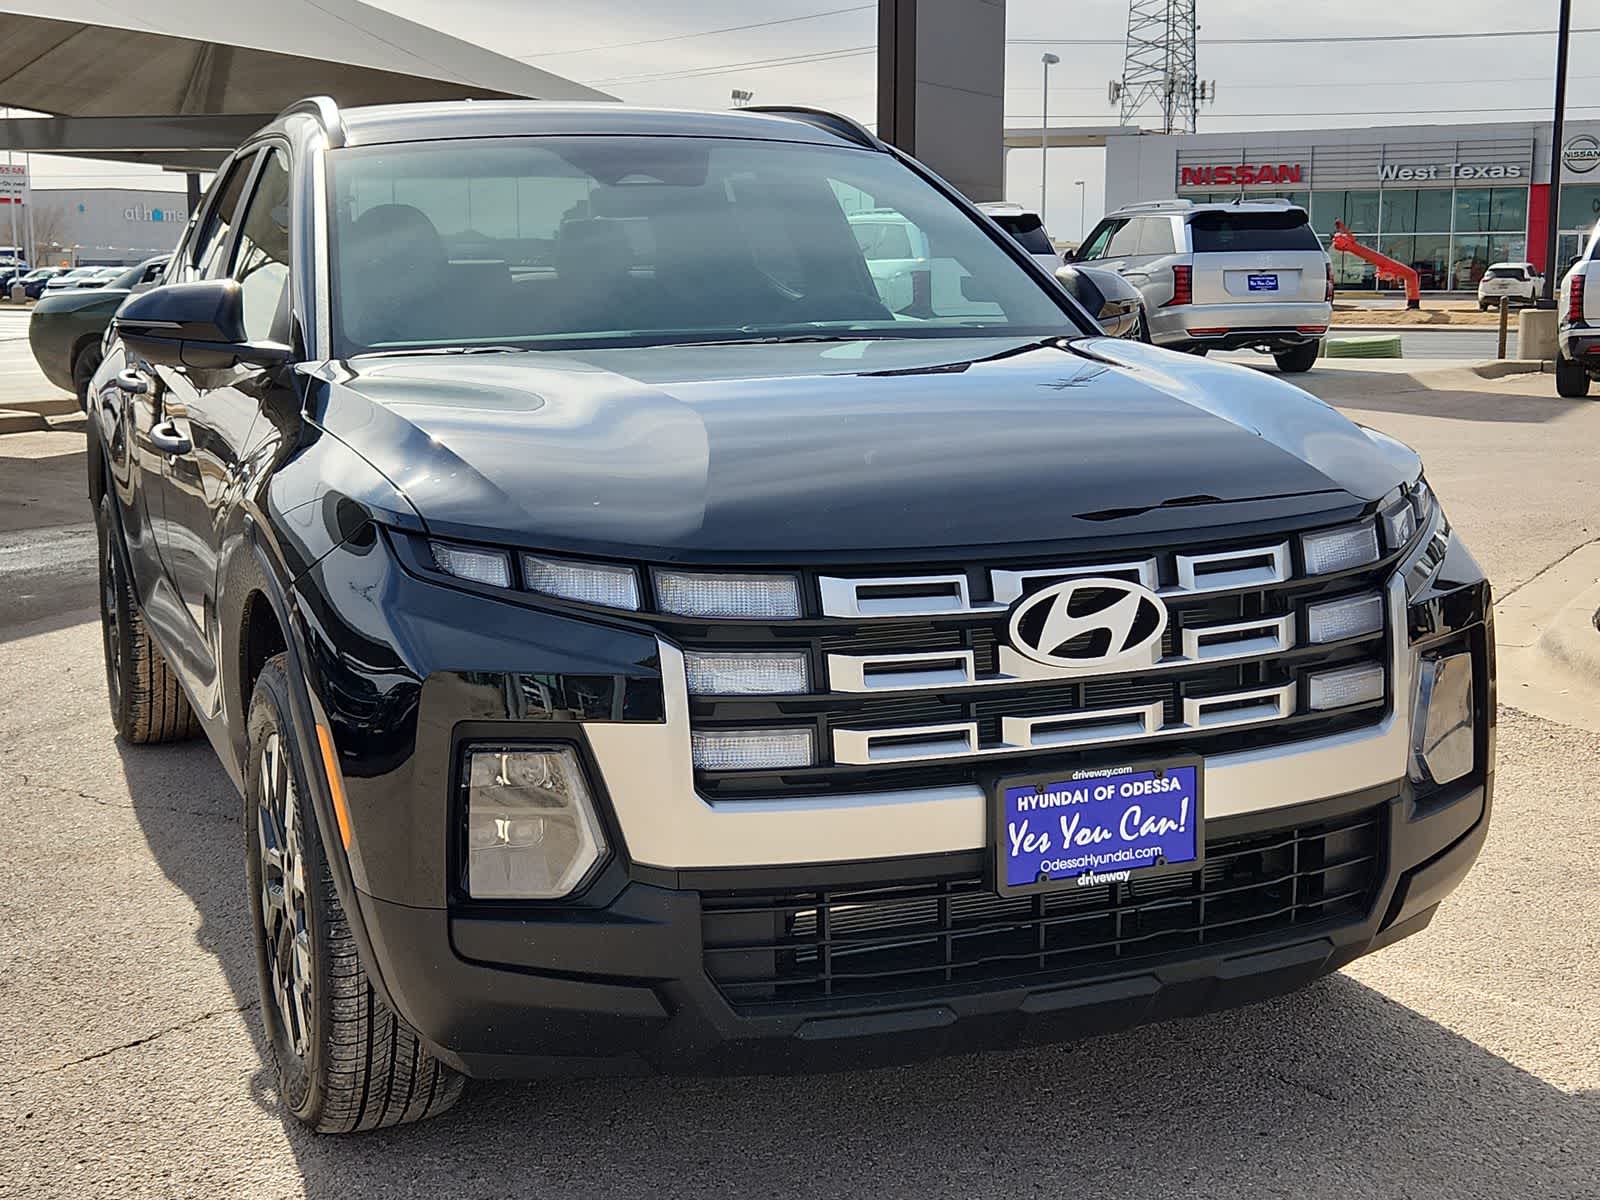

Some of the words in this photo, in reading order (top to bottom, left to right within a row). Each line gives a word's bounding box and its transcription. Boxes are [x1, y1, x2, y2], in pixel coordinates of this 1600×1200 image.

[1563, 150, 1600, 158] NISSAN
[1181, 164, 1300, 185] NISSAN
[1377, 164, 1438, 181] West
[1445, 162, 1521, 179] Texas
[124, 204, 138, 220] at
[1072, 765, 1133, 780] driveway.com
[1017, 790, 1089, 811] HYUNDAI
[1093, 785, 1116, 801] OF
[1119, 777, 1181, 798] ODESSA
[1008, 819, 1051, 857] Yes
[1060, 812, 1112, 850] You
[1119, 797, 1189, 841] Can!
[1040, 846, 1162, 873] OdessaHyundai.com
[1077, 870, 1131, 887] driveway
